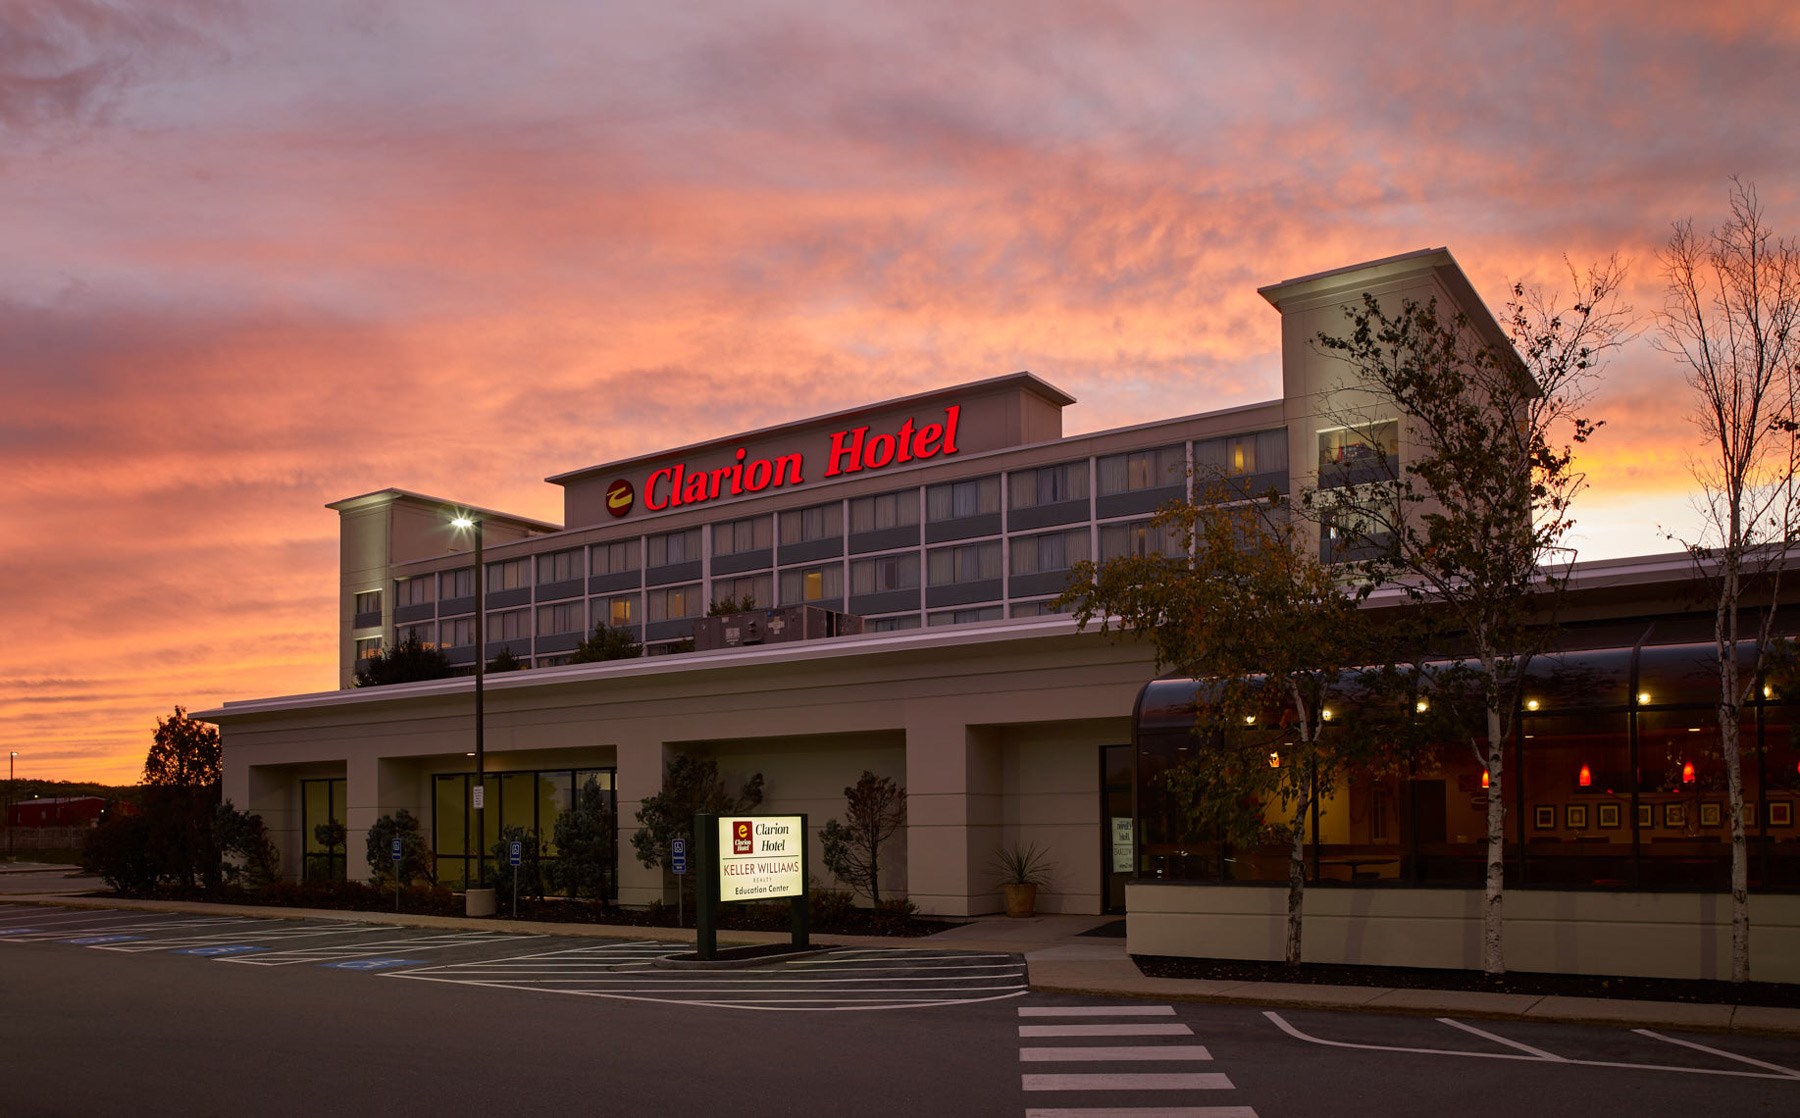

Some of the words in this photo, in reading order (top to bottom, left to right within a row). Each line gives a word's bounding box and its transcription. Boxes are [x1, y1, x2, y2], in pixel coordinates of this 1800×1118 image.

[644, 448, 804, 511] Clarion
[824, 404, 961, 478] Hotel
[755, 822, 789, 836] Clarion
[761, 839, 786, 852] Hotel
[723, 863, 756, 876] KELLER
[757, 861, 800, 874] WILLIAMS
[735, 886, 767, 895] Education
[768, 884, 789, 893] Center
